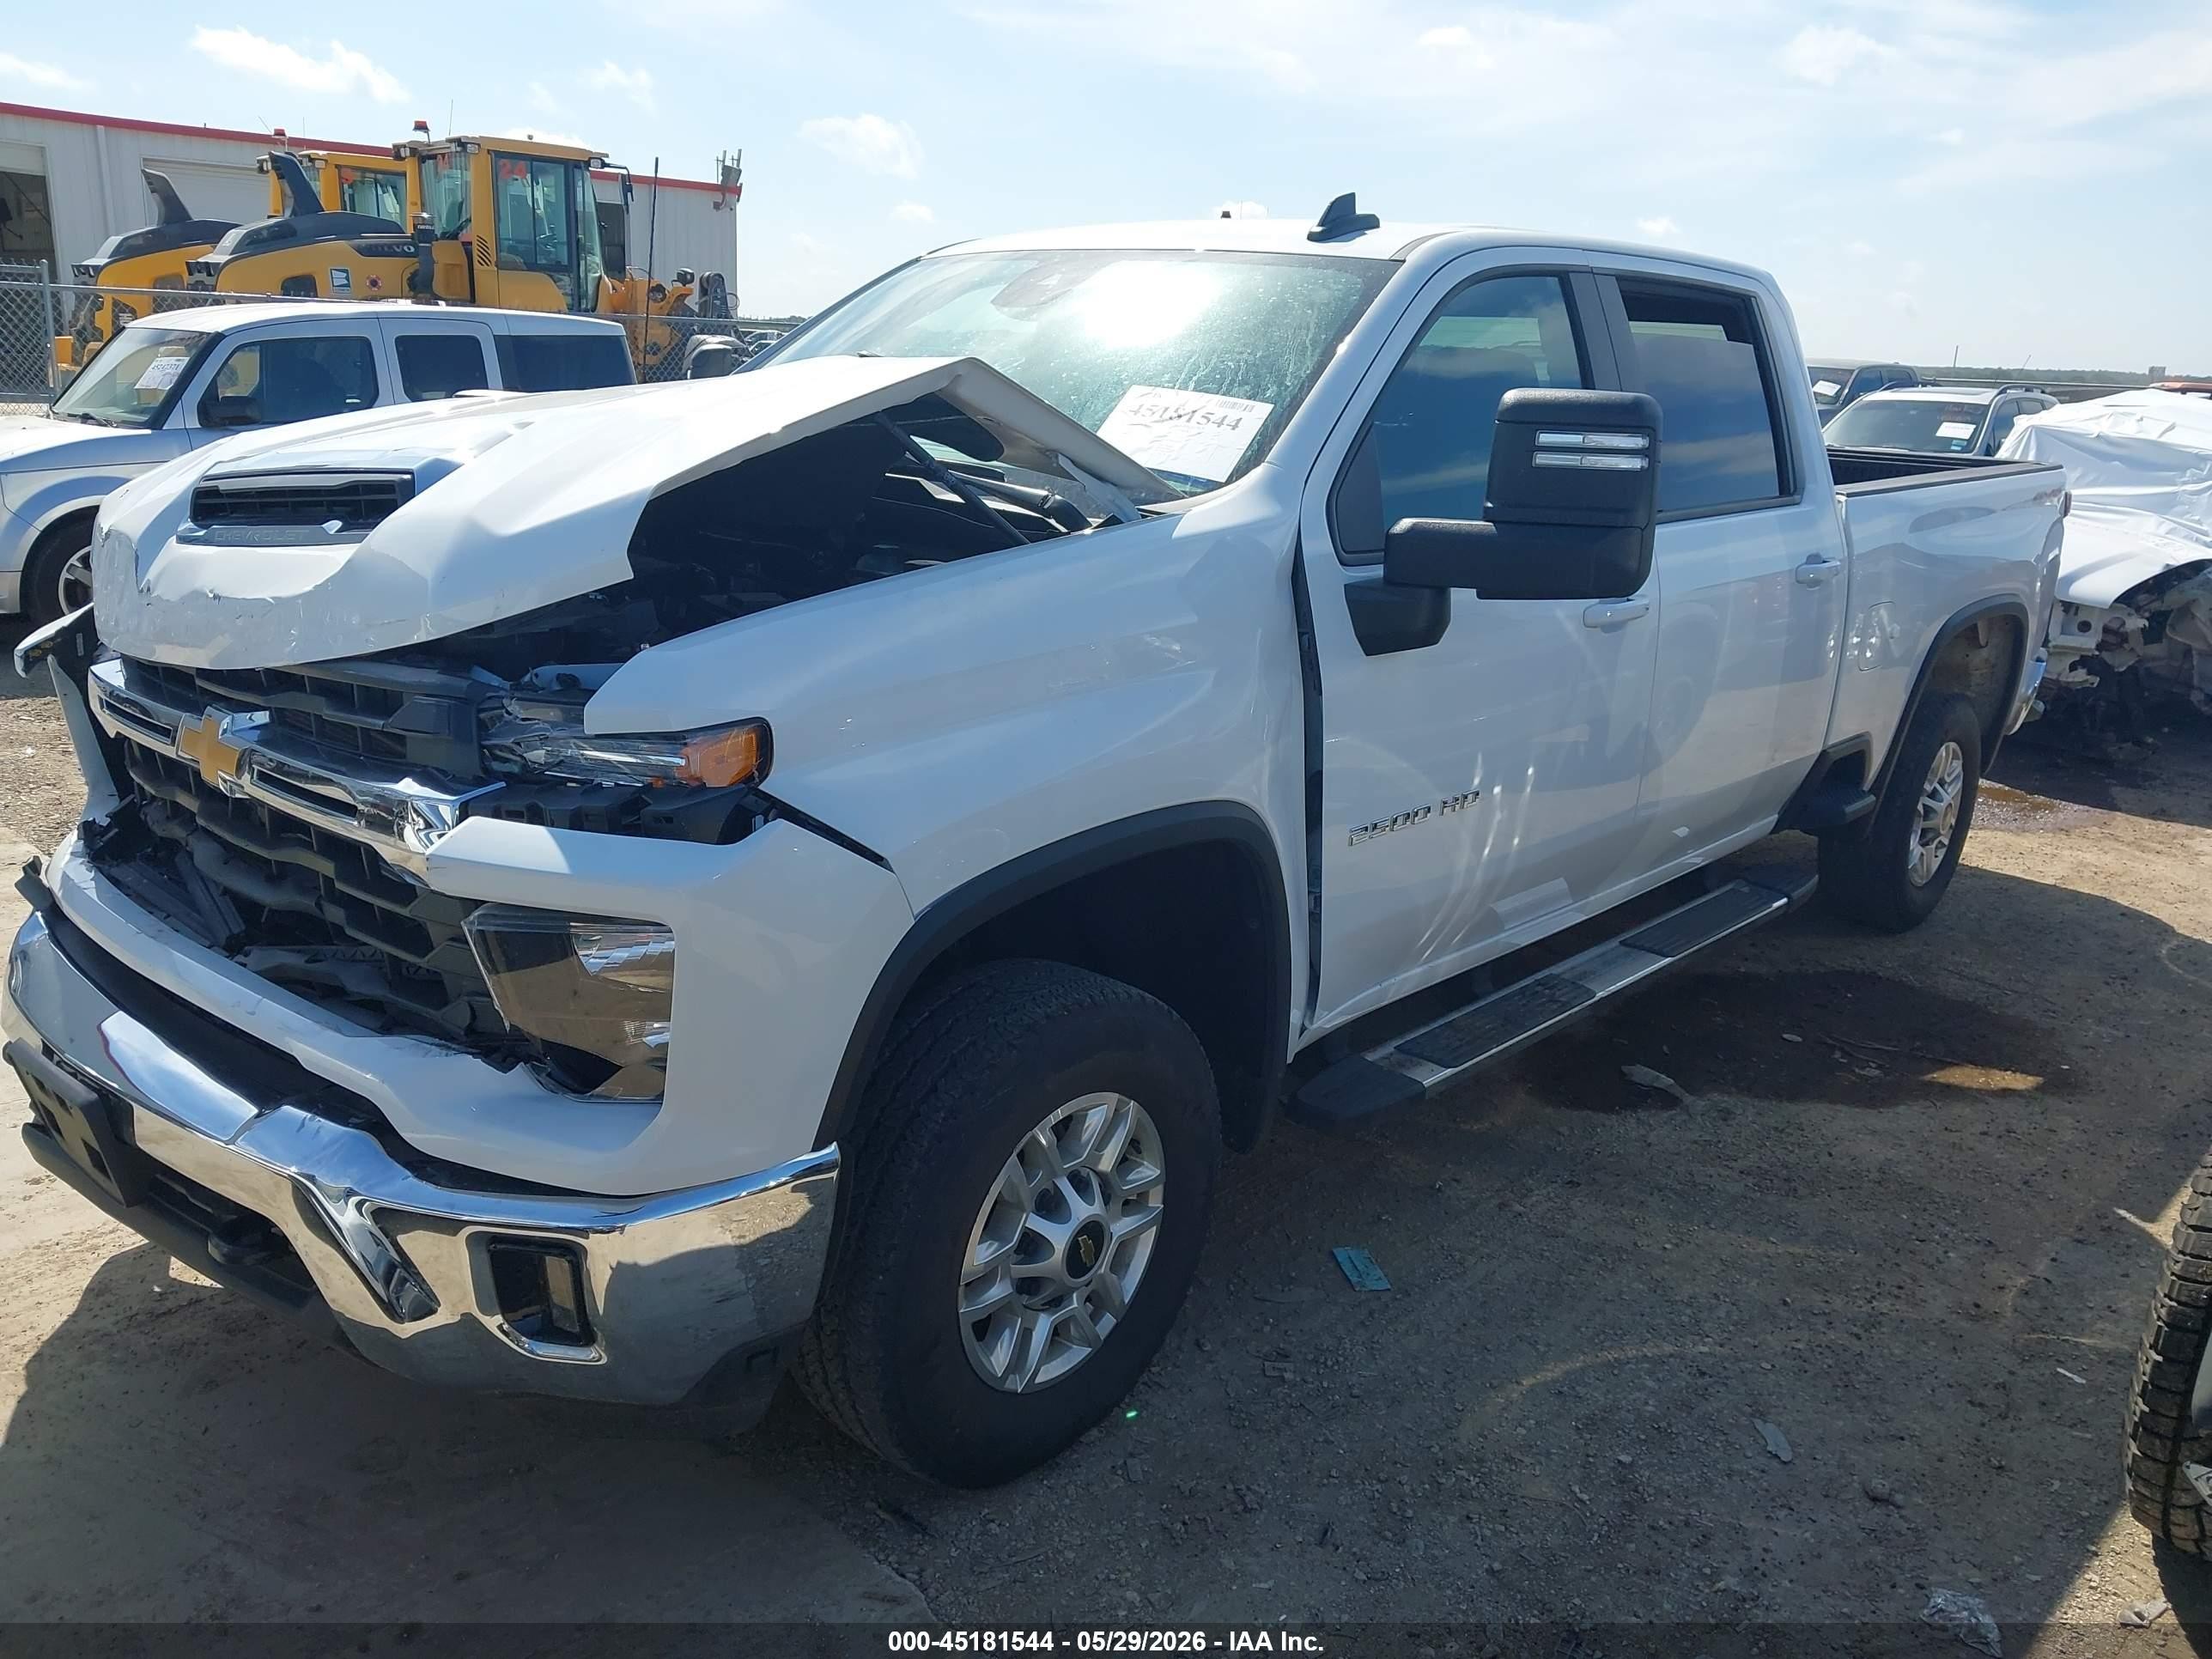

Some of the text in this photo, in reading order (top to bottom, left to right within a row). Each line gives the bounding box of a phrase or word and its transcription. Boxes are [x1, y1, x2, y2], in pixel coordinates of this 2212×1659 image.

[1128, 403, 1243, 431] 45181544
[215, 529, 310, 542] CHEVROLET
[1347, 789, 1480, 847] 2500 HD
